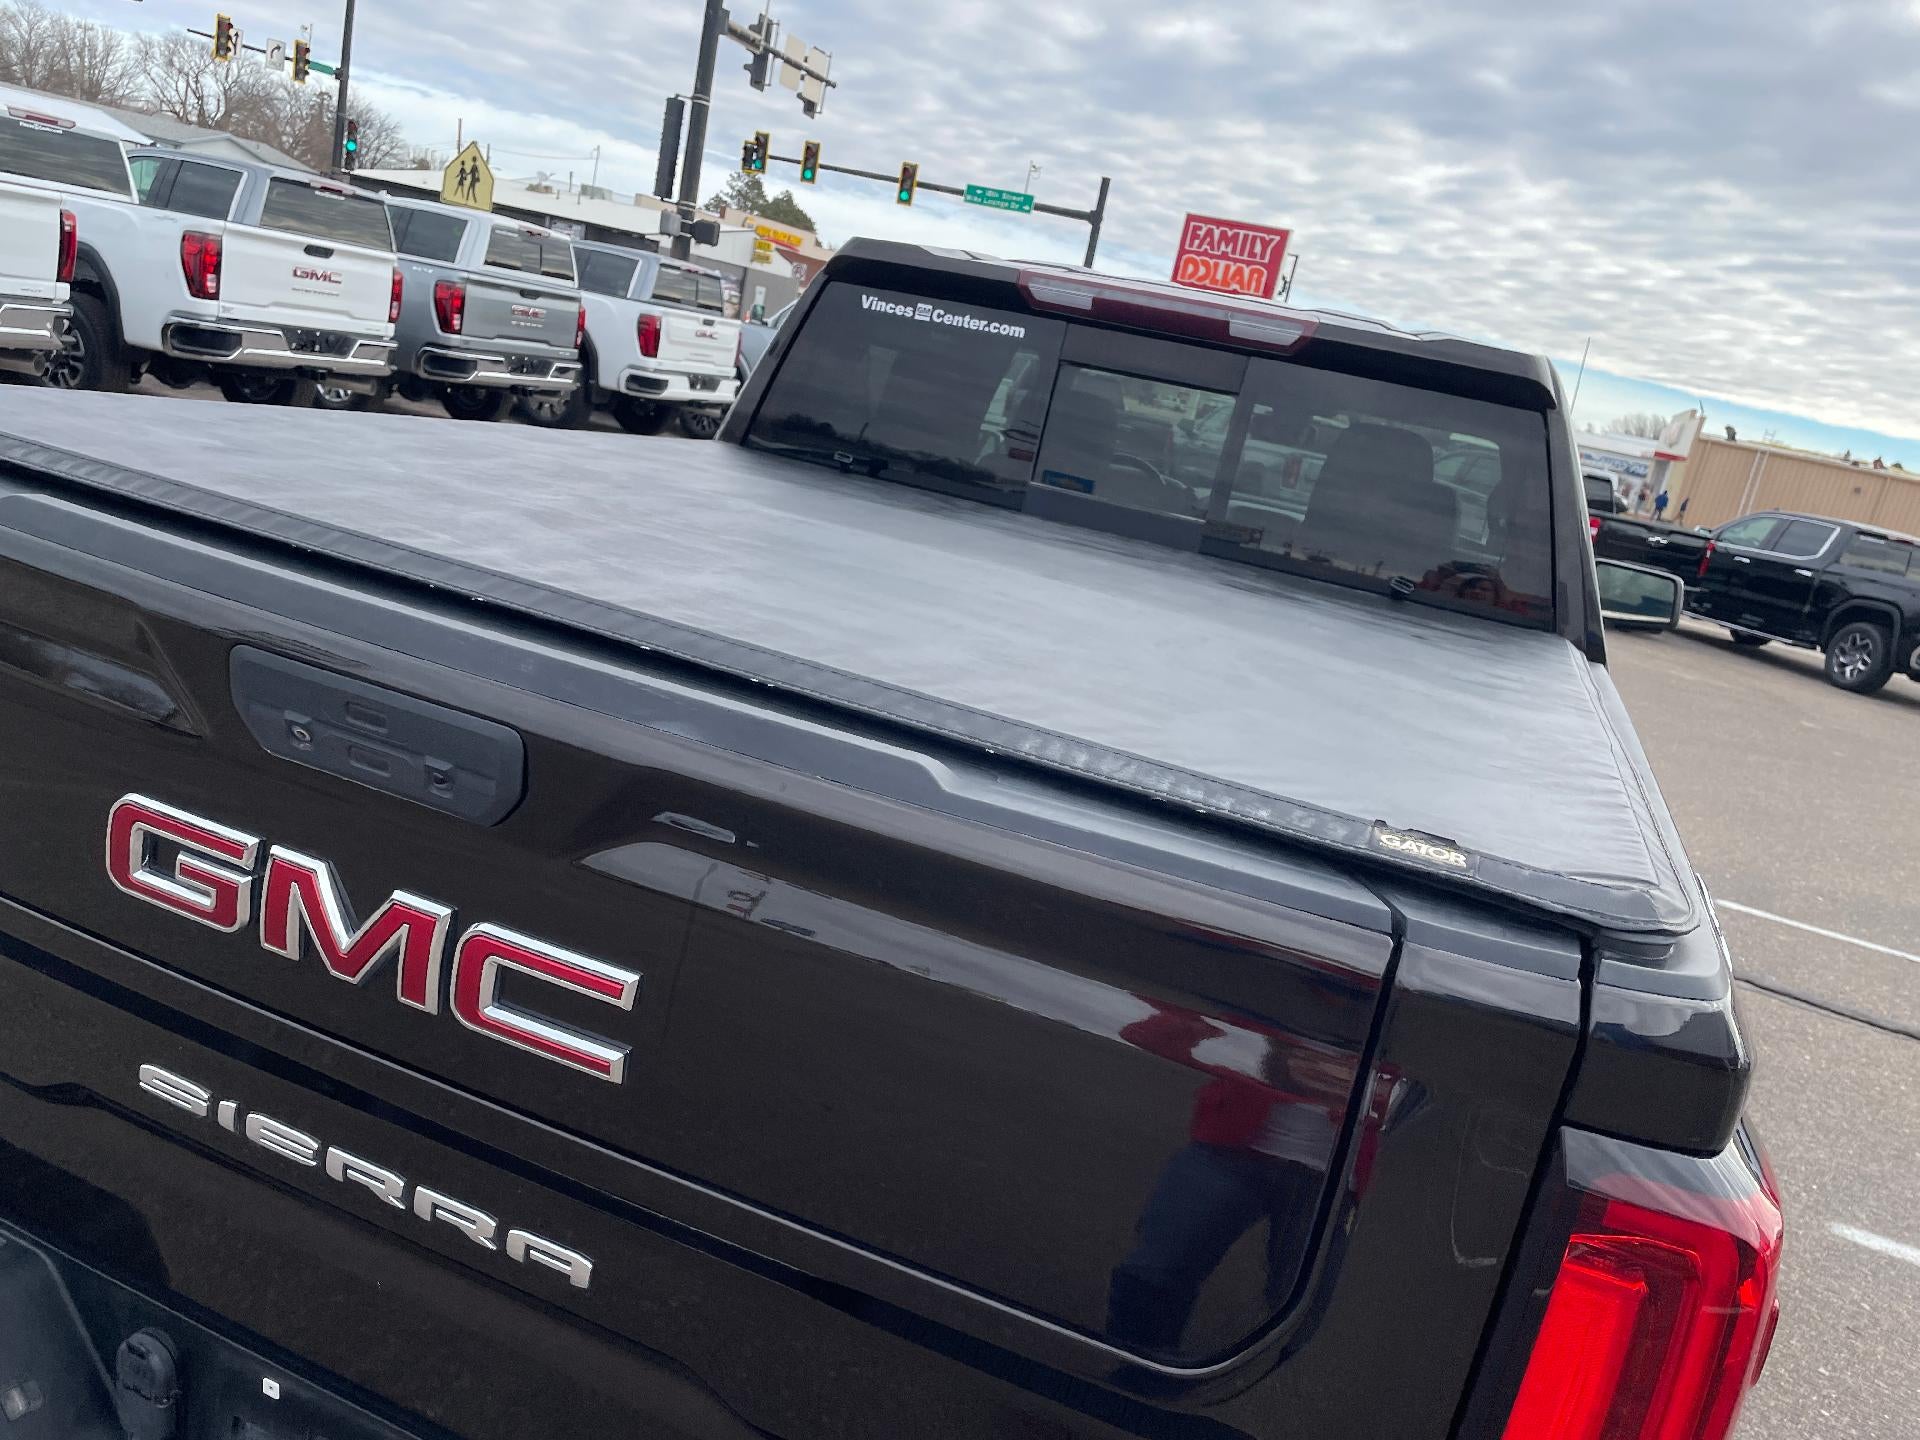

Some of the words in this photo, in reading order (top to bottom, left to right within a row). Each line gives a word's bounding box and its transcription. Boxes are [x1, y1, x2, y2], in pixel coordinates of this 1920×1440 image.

[1002, 192, 1024, 202] Street
[1185, 222, 1281, 263] FAMILY
[292, 266, 342, 284] GMC
[1177, 254, 1267, 296] DOLLAR
[1380, 834, 1467, 869] GATOR
[106, 793, 641, 1085] GMC
[138, 1063, 595, 1289] SIERRA
